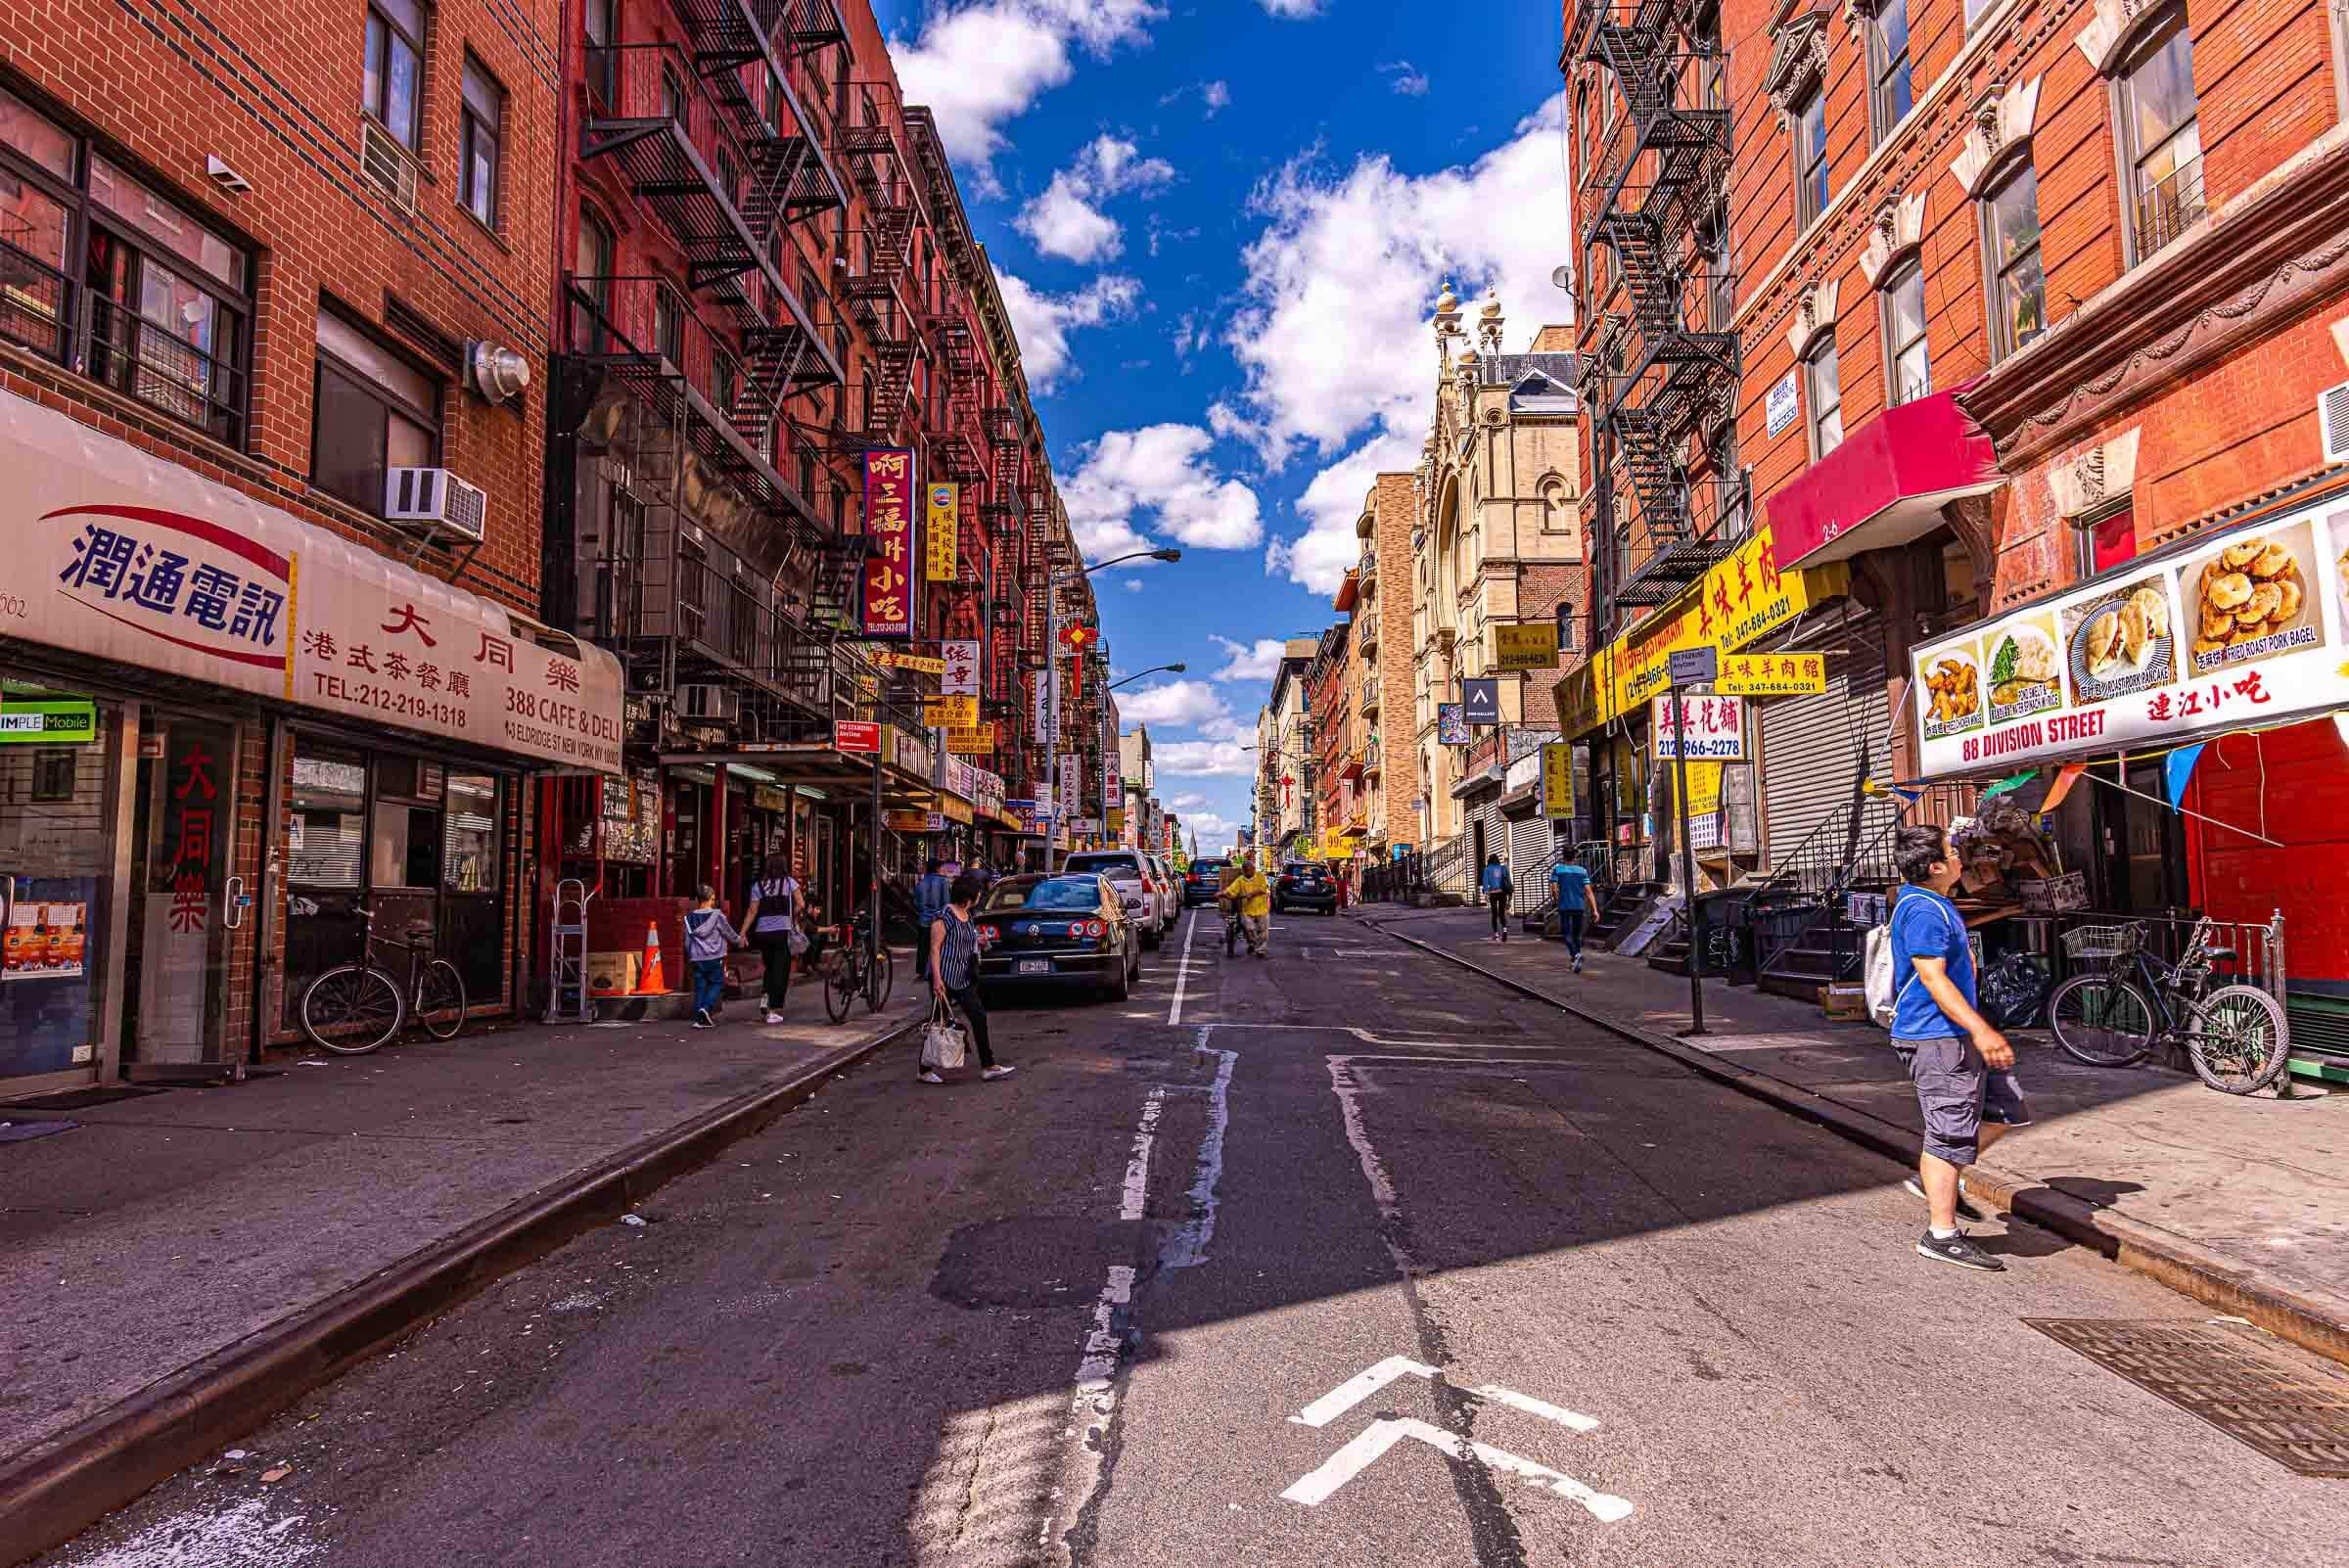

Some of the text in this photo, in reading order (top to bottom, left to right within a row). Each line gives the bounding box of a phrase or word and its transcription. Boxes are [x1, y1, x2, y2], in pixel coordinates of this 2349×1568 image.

[1822, 522, 1838, 542] 2-6
[59, 524, 285, 647] 潤通電訊
[1699, 539, 1801, 641] 美味羊肉
[1735, 594, 1791, 641] 347-684-0321
[2227, 625, 2316, 661] FRIED ROAST PORK BAGEL
[312, 671, 467, 729] TEL:212-219-1318
[1727, 682, 1816, 692] Tel: 347-684-0321
[2146, 669, 2272, 721] 連江小吃
[45, 715, 87, 730] Mobile
[505, 686, 535, 718] 388
[539, 698, 576, 731] CAFE
[578, 711, 590, 733] &
[592, 714, 620, 743] DELI
[1962, 737, 1979, 761] 88
[1983, 720, 2044, 758] DIVISION
[2048, 709, 2106, 745] STREET
[562, 737, 576, 758] NEW
[577, 741, 595, 762] YORK
[1658, 739, 1740, 757] 212966-2278
